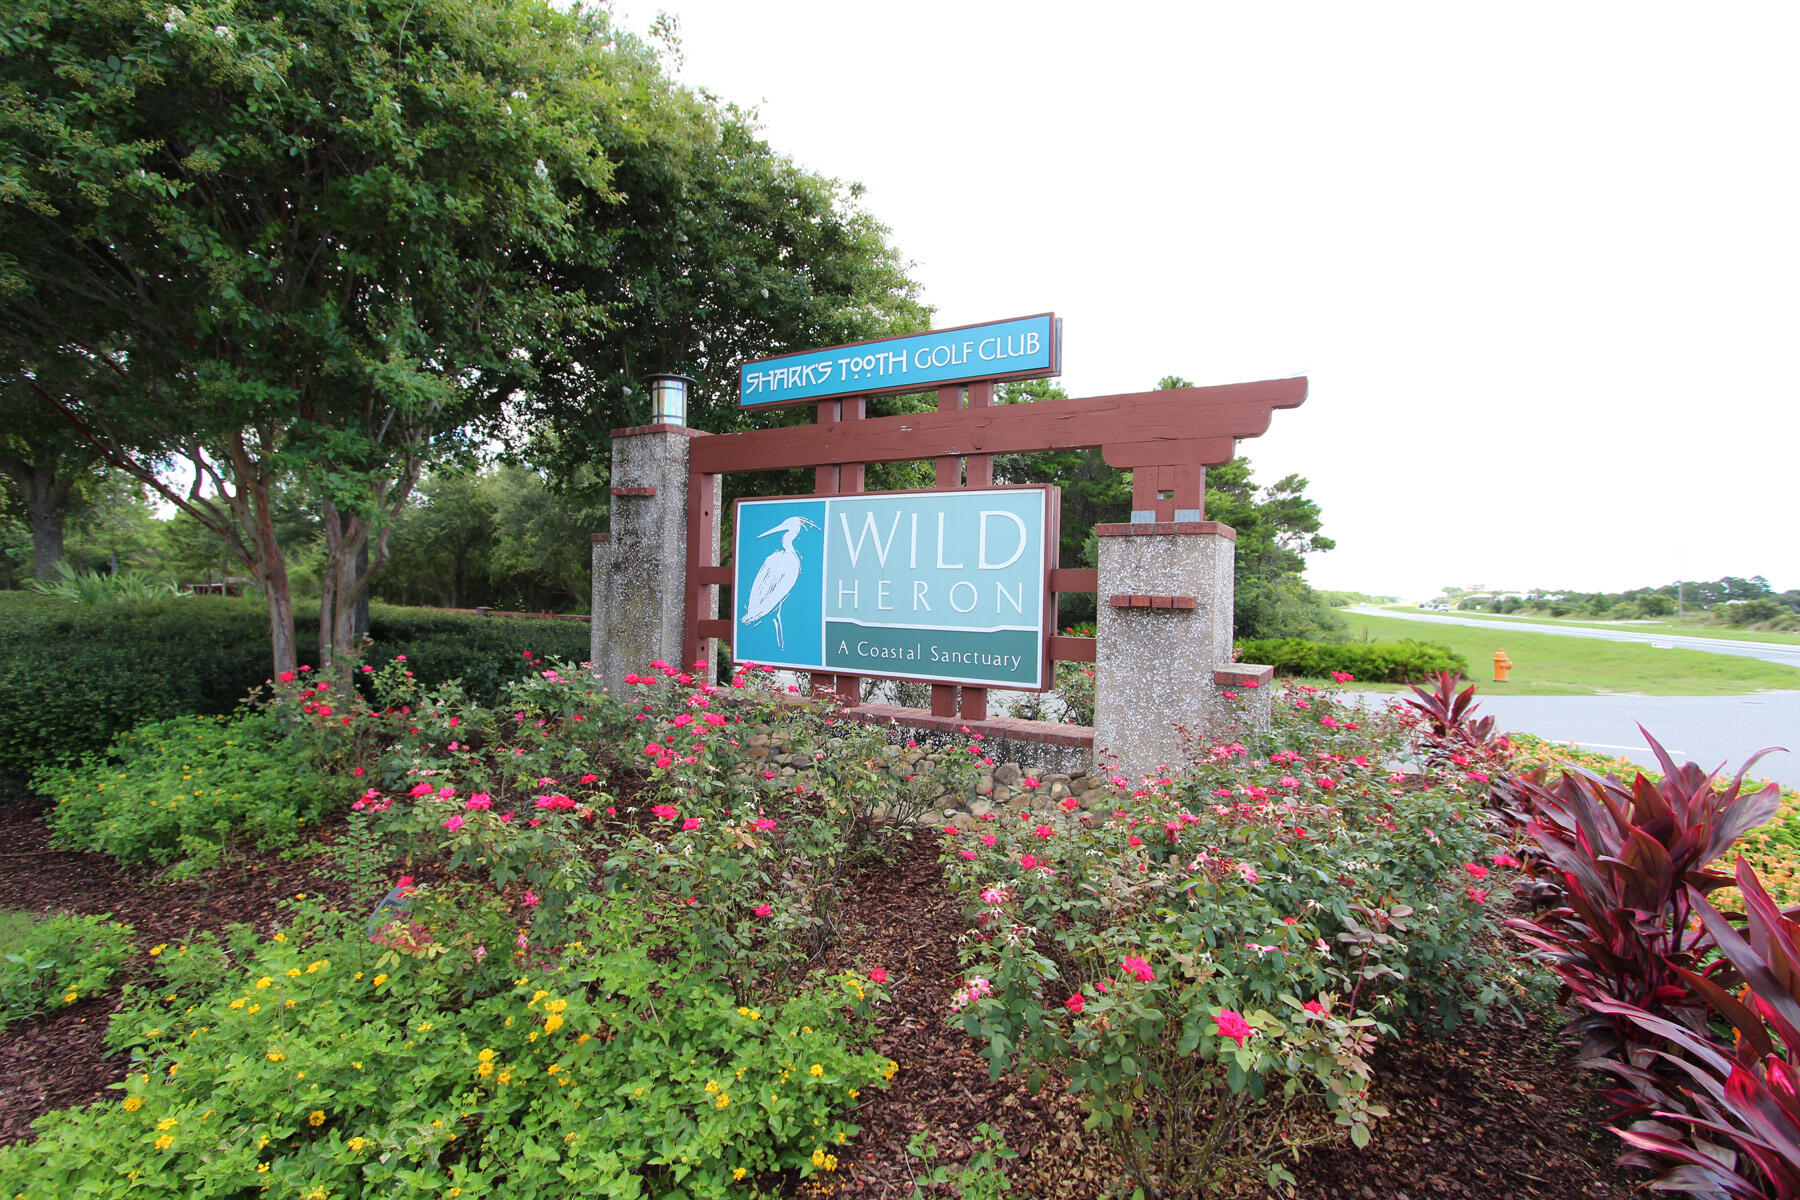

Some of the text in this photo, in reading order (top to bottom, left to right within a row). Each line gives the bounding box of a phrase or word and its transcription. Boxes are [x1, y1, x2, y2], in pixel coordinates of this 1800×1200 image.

[838, 350, 908, 380] TOOTH
[914, 341, 973, 370] GOLF
[979, 332, 1041, 361] CLUB
[839, 510, 1027, 570] WILD
[837, 579, 1023, 616] HERON
[838, 640, 1022, 671] A Coastal Sanctuary
